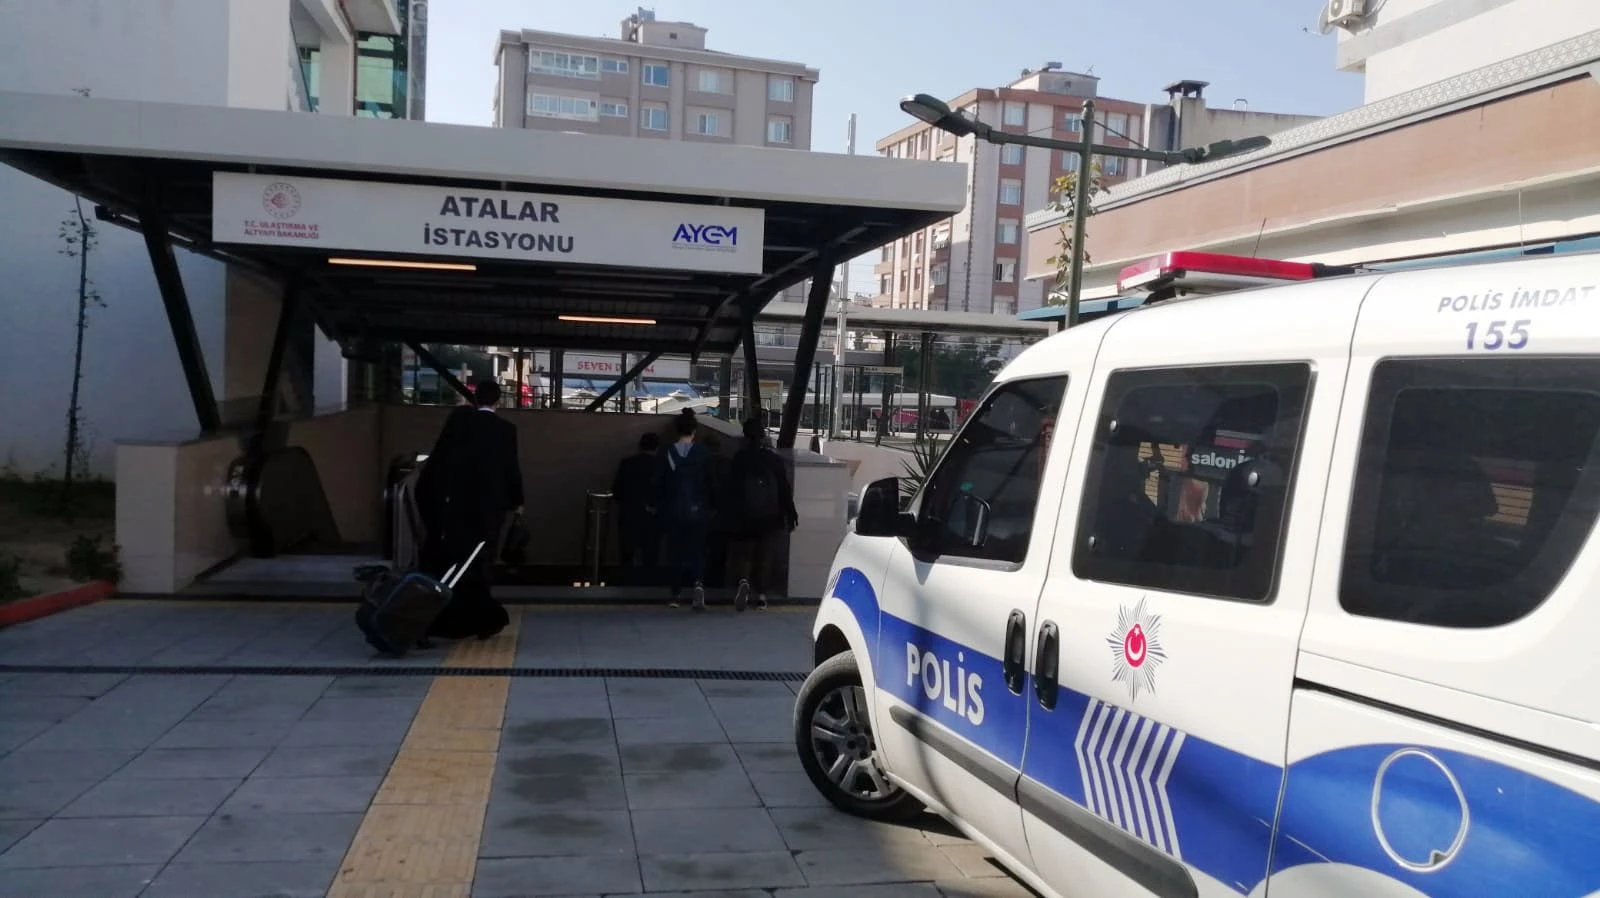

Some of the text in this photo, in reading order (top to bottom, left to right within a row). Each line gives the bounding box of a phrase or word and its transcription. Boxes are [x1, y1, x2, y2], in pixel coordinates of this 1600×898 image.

[440, 196, 560, 222] ATALAR
[424, 222, 573, 253] İSTASYONU
[1437, 286, 1596, 312] POLİS İMDAT
[1465, 319, 1531, 351] 155
[577, 361, 612, 371] SEVEN
[906, 641, 985, 726] POLİS
